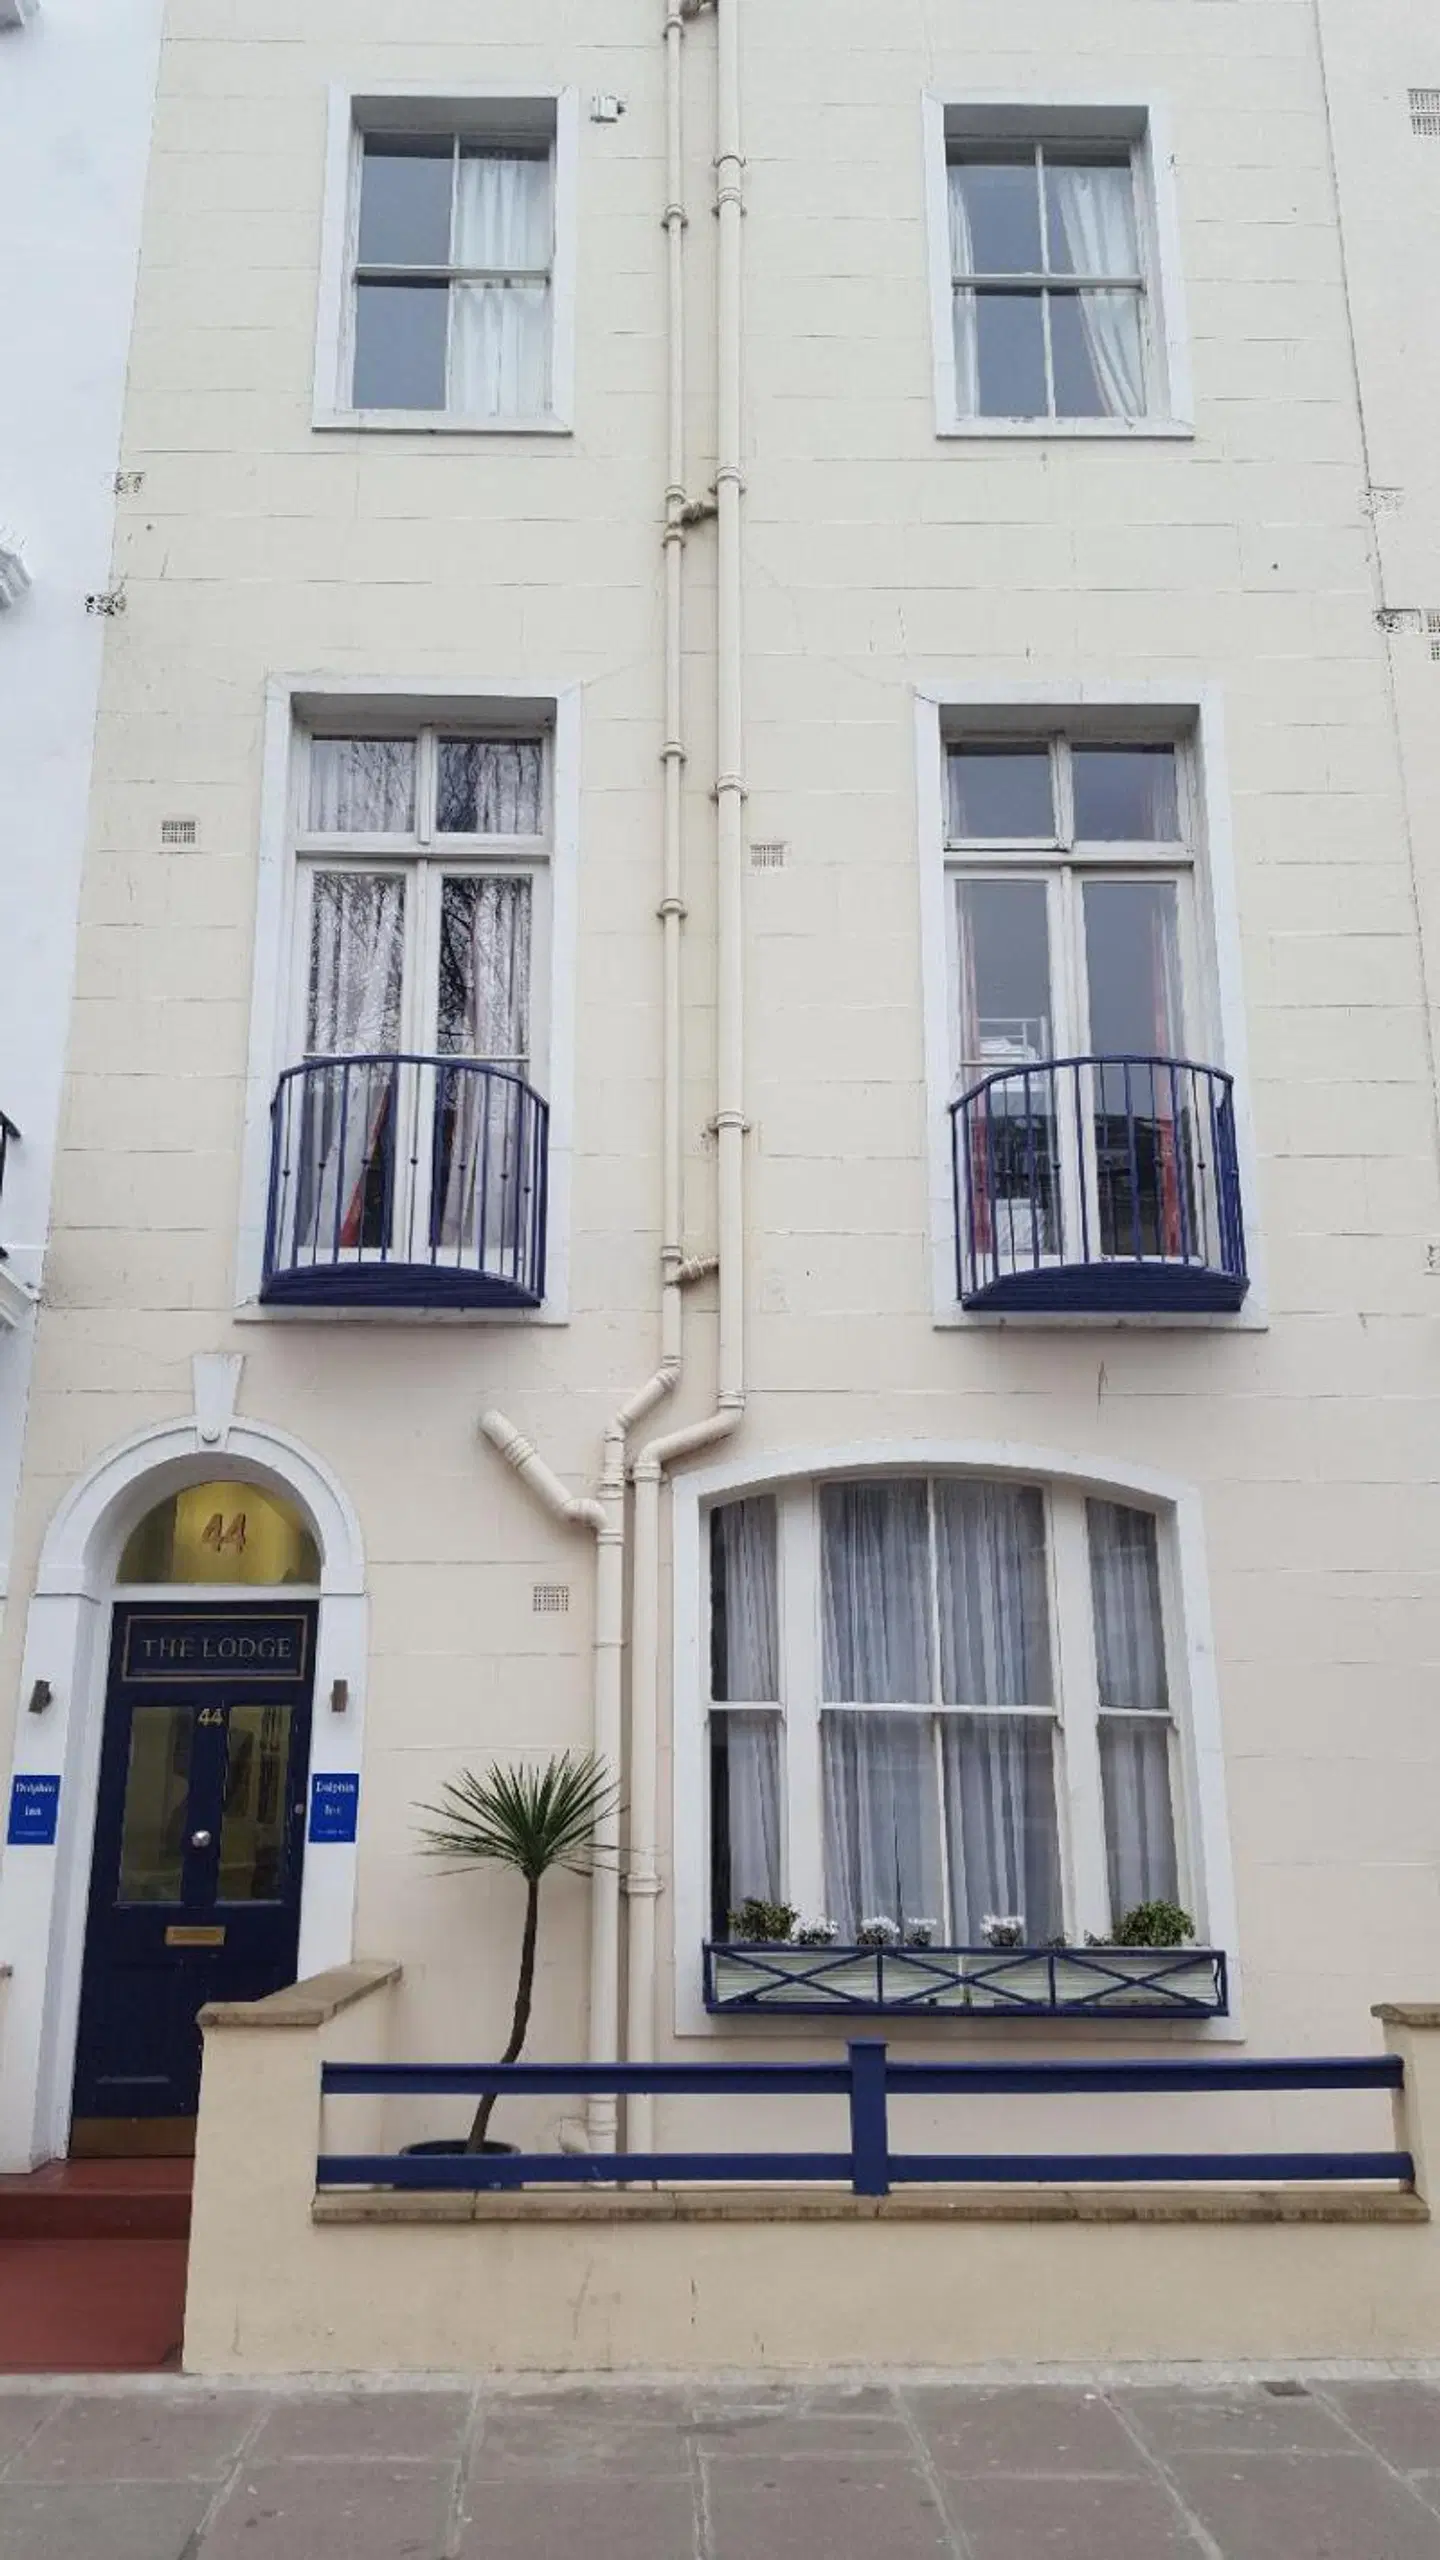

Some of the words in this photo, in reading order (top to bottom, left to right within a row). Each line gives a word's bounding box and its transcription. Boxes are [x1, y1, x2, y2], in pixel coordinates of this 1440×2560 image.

[201, 1512, 247, 1554] 44
[141, 1637, 195, 1658] THE
[202, 1636, 292, 1659] LODGE
[198, 1707, 224, 1726] 44
